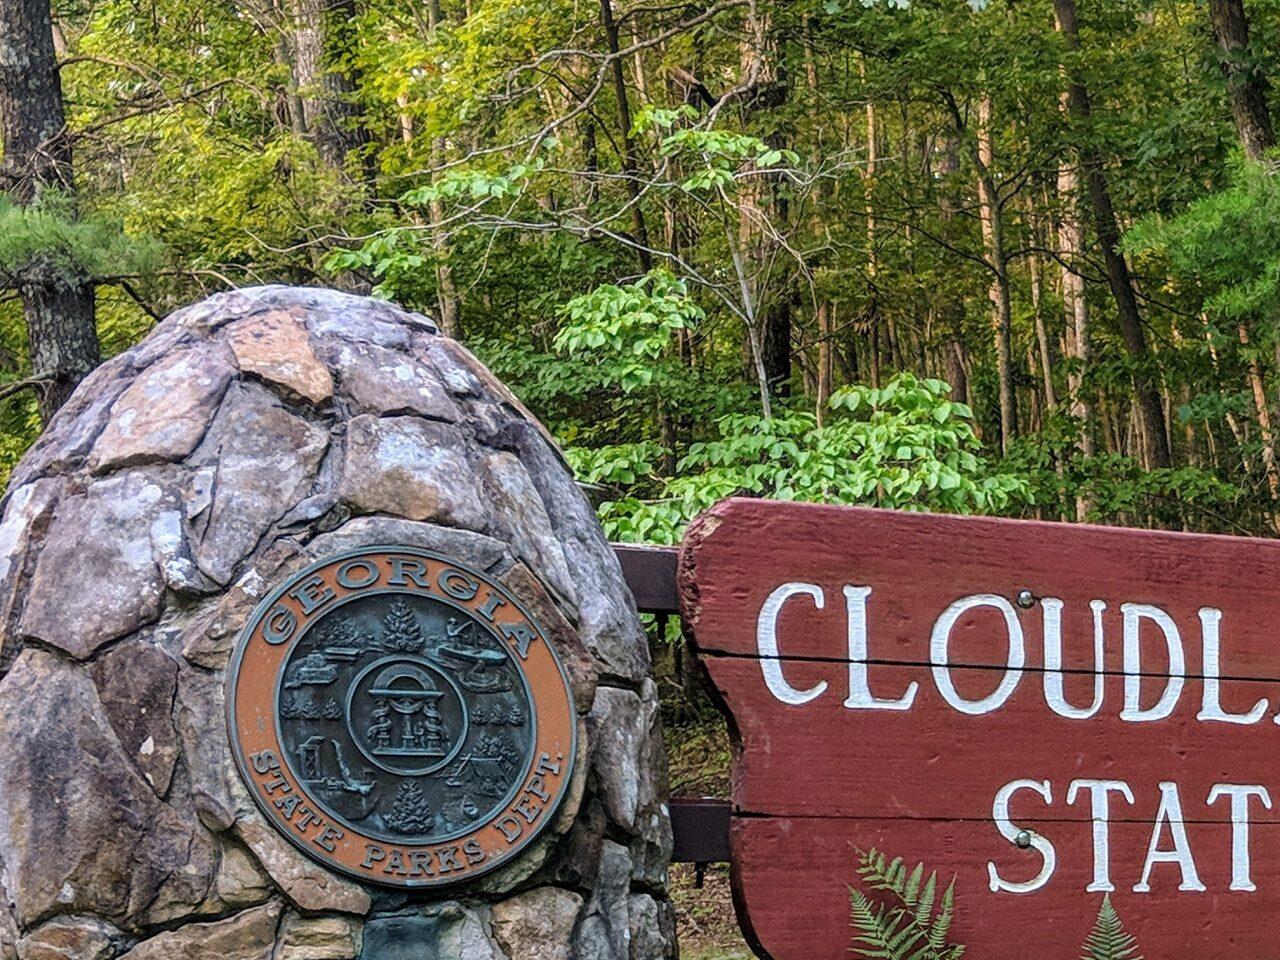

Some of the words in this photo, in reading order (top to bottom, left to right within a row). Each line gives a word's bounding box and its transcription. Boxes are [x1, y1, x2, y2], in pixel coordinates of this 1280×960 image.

[261, 556, 539, 660] GEORGIA
[251, 749, 345, 853] STATE
[359, 839, 488, 876] PARKS
[495, 750, 565, 844] DEPT.
